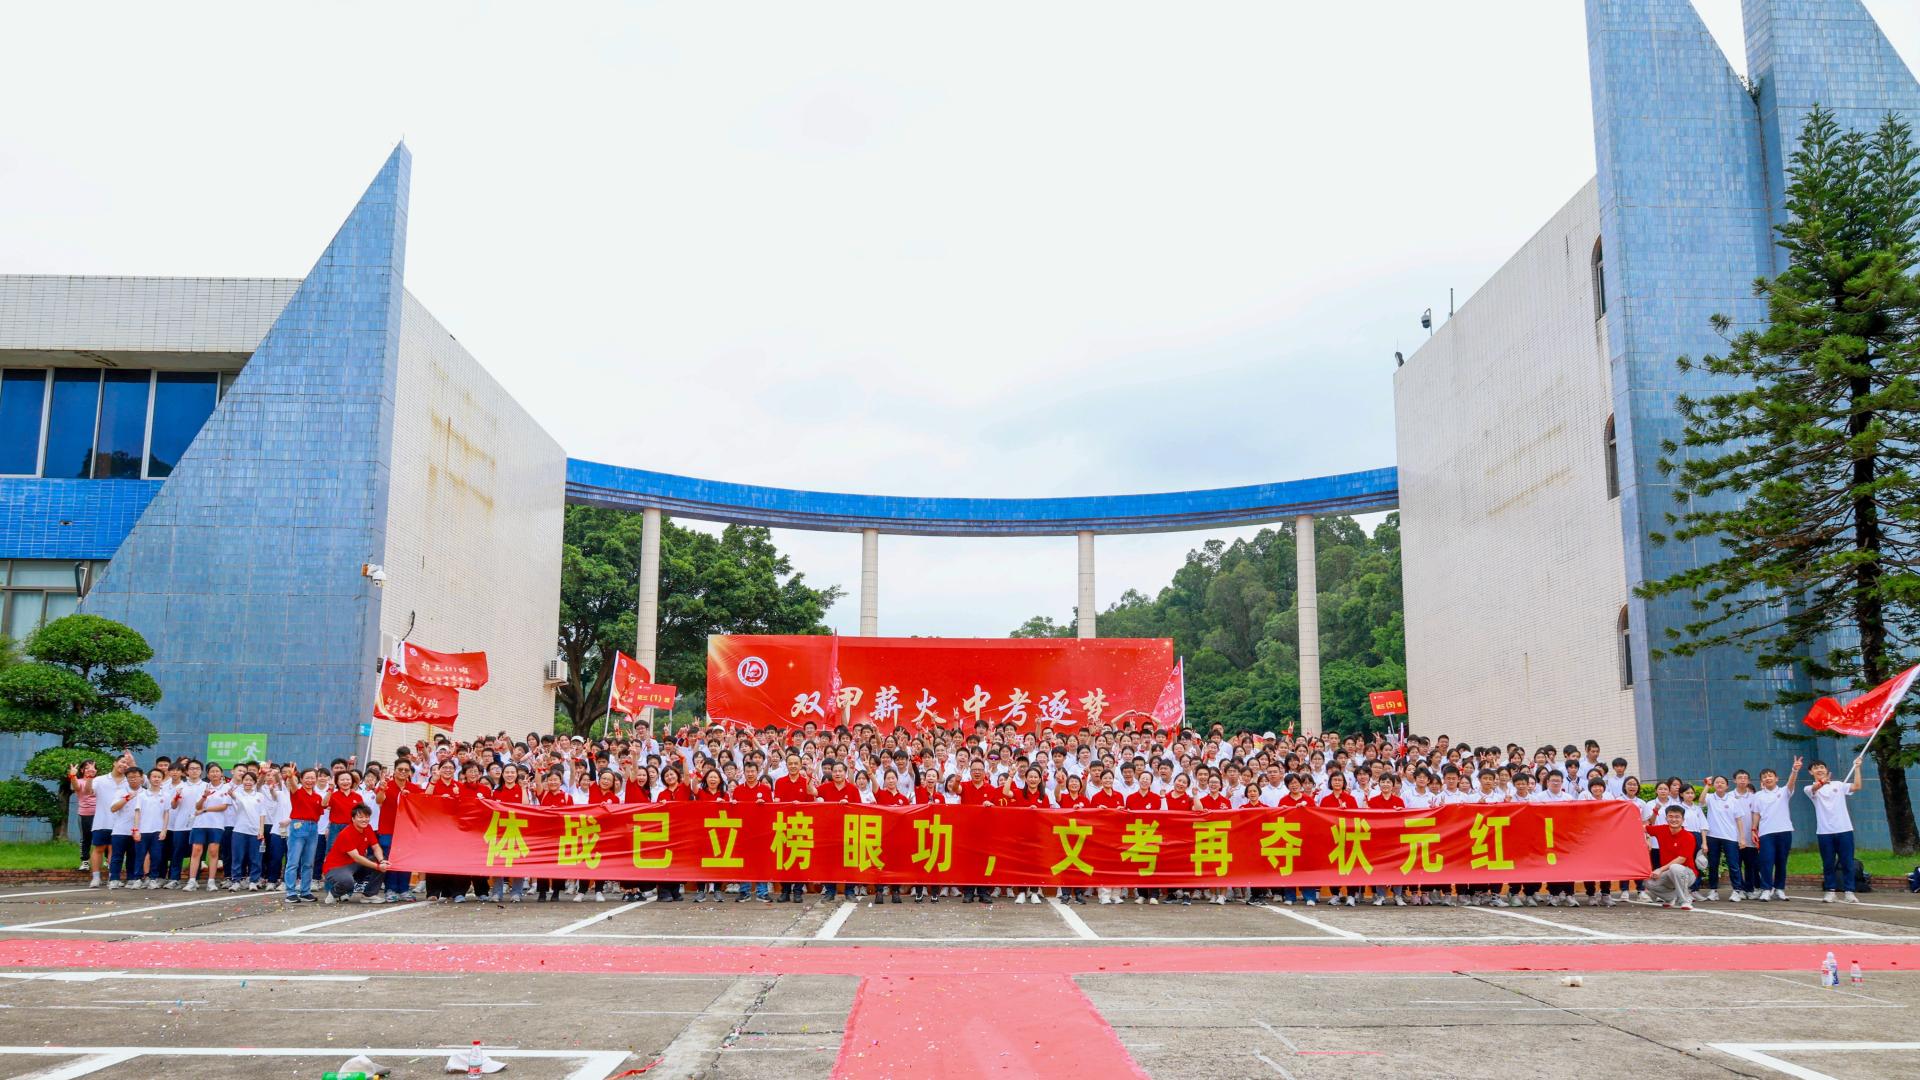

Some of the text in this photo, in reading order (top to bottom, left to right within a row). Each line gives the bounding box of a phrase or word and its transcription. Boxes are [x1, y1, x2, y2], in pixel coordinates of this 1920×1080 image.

[790, 684, 1110, 726] 双甲薪火中考逐梦
